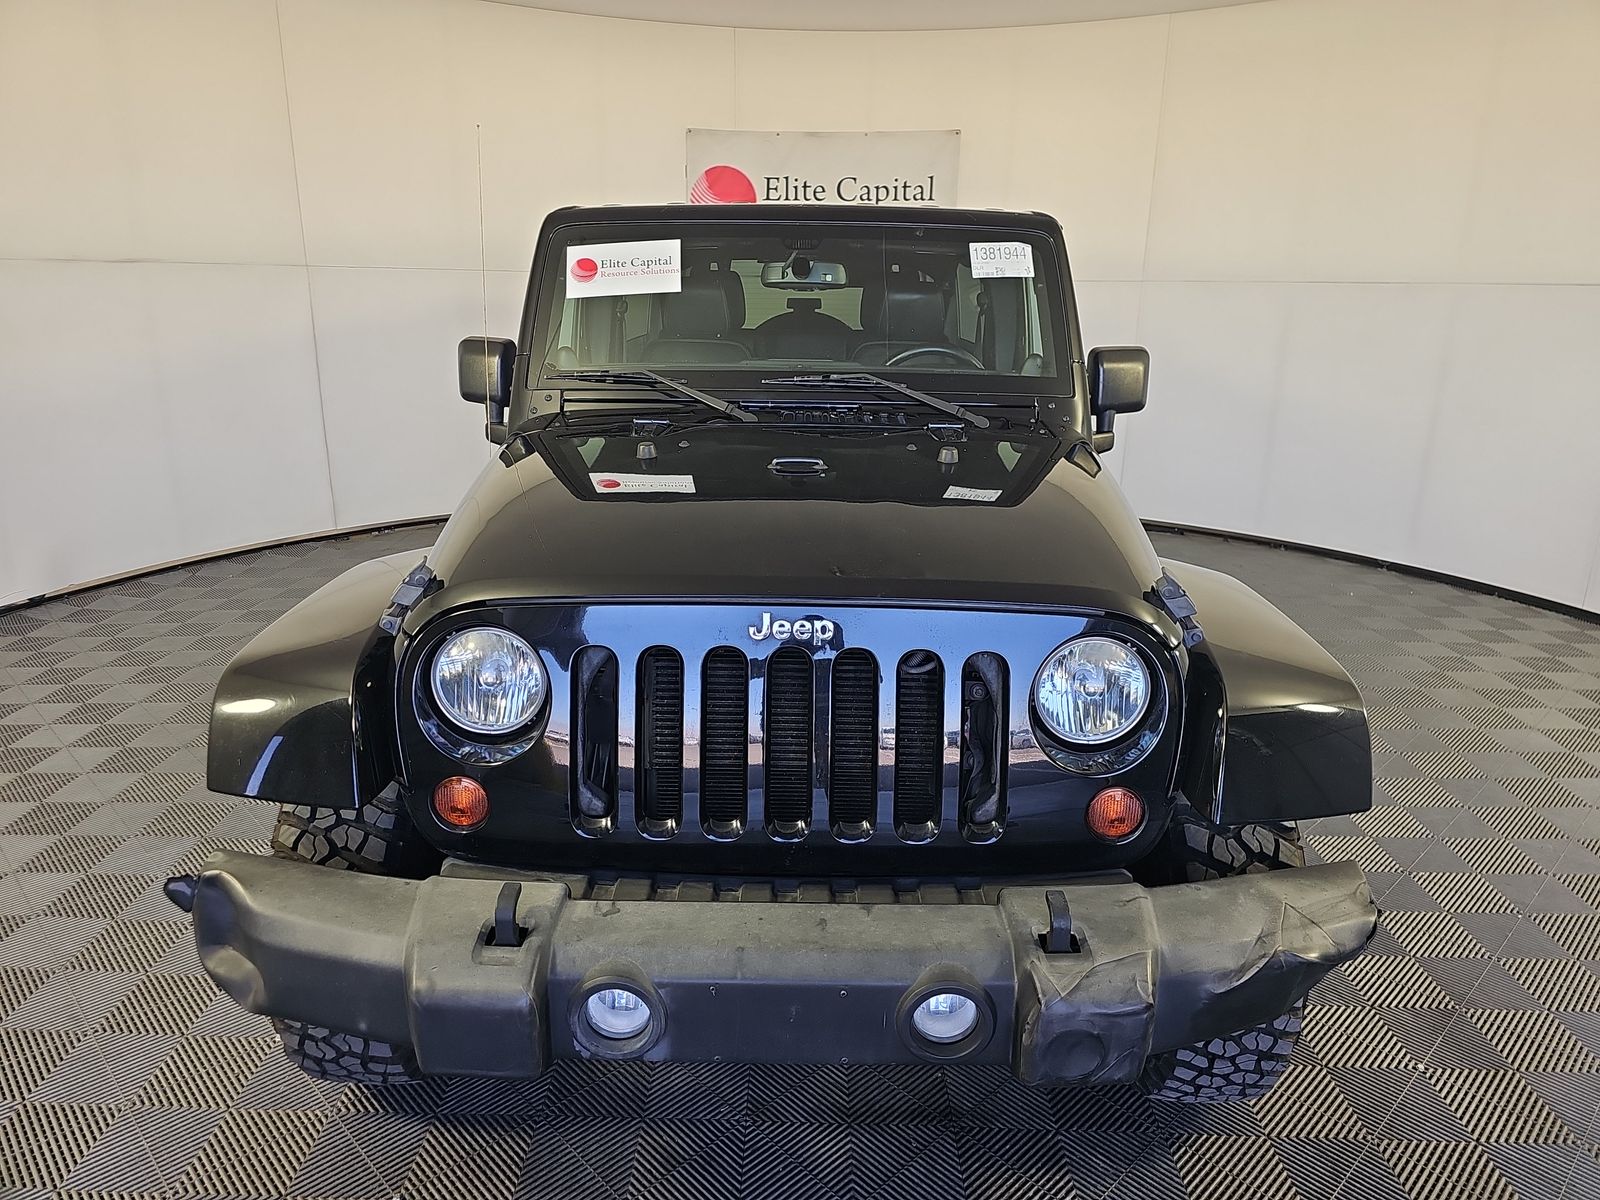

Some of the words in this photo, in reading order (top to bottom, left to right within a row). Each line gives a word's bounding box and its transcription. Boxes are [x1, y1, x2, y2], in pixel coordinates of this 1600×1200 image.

[763, 176, 826, 202] Elite
[836, 175, 936, 205] Capital
[972, 246, 1027, 261] 1381944
[600, 259, 627, 269] Elite
[630, 255, 673, 269] Capital
[600, 270, 639, 278] Resource
[640, 267, 680, 276] Solutions
[748, 612, 834, 645] Jeep
